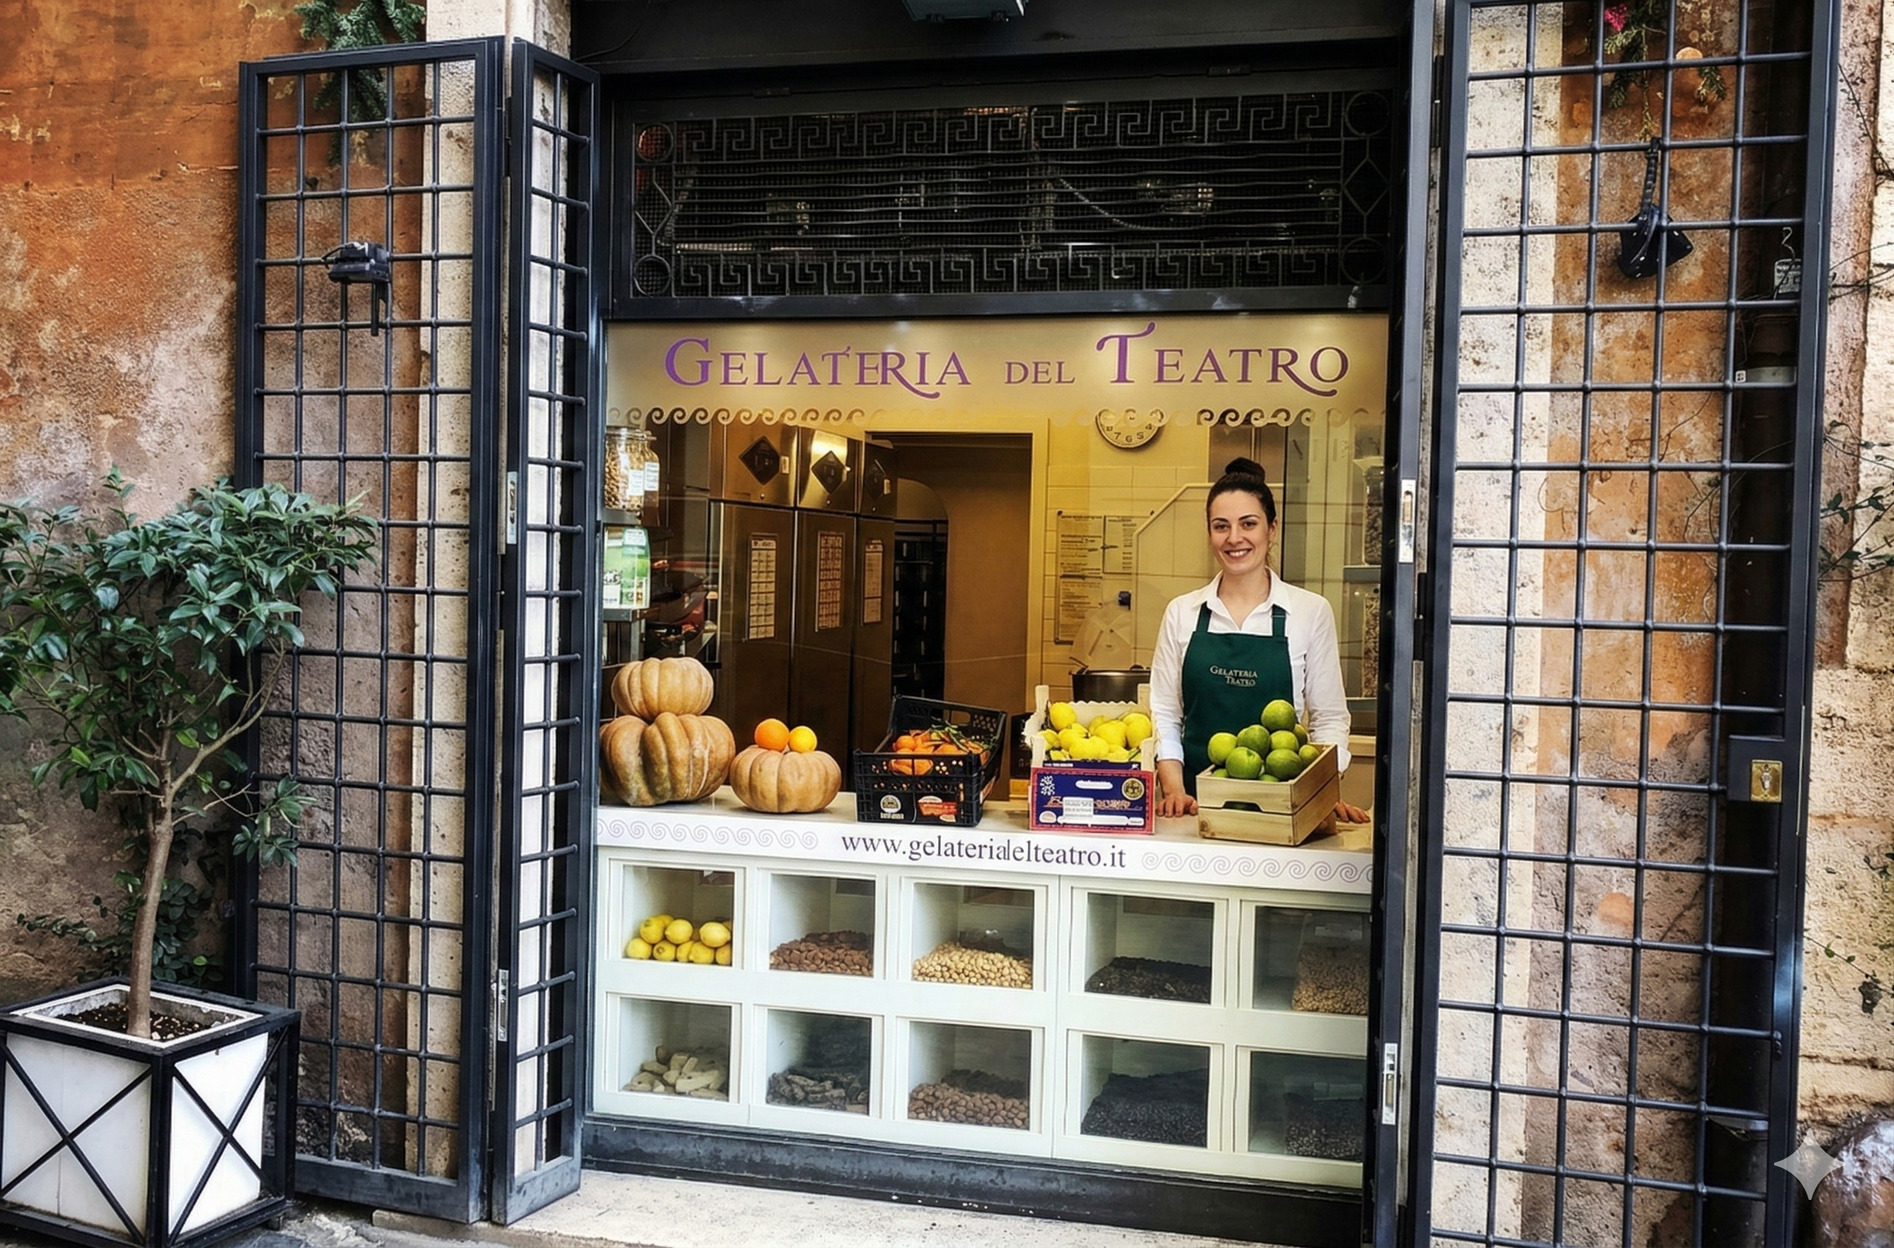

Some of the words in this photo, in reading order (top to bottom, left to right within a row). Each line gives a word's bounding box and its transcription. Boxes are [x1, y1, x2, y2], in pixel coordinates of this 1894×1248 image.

[664, 337, 972, 399] GELATERIA
[1004, 361, 1076, 385] DEL
[1096, 322, 1349, 397] TEATRO
